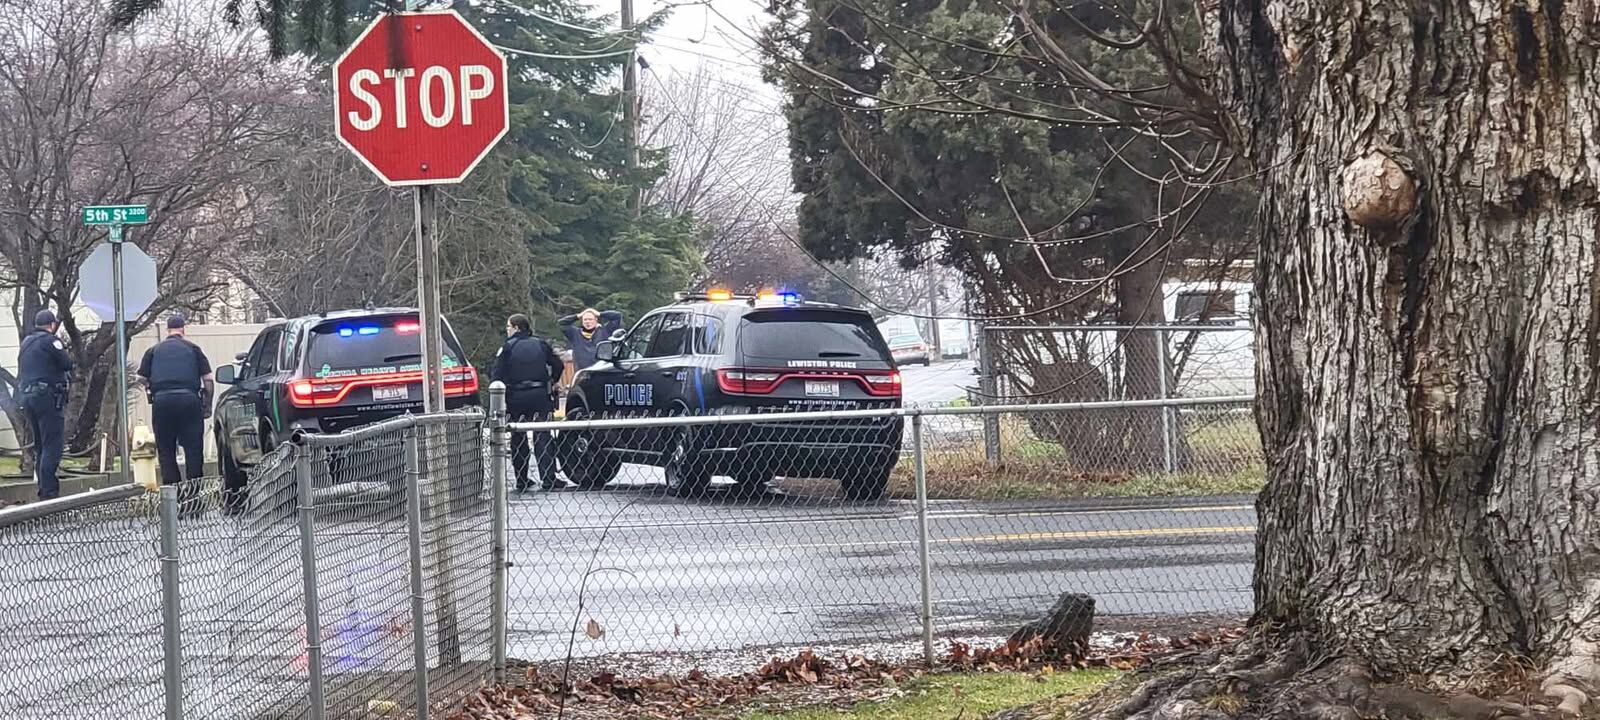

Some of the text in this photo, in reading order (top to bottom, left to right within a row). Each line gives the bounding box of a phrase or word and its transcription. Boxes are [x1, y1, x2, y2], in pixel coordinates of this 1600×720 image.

[349, 65, 495, 131] STOP
[86, 209, 127, 221] 5th St
[787, 360, 857, 369] LEWISTON POLICE
[604, 383, 653, 406] POLICE
